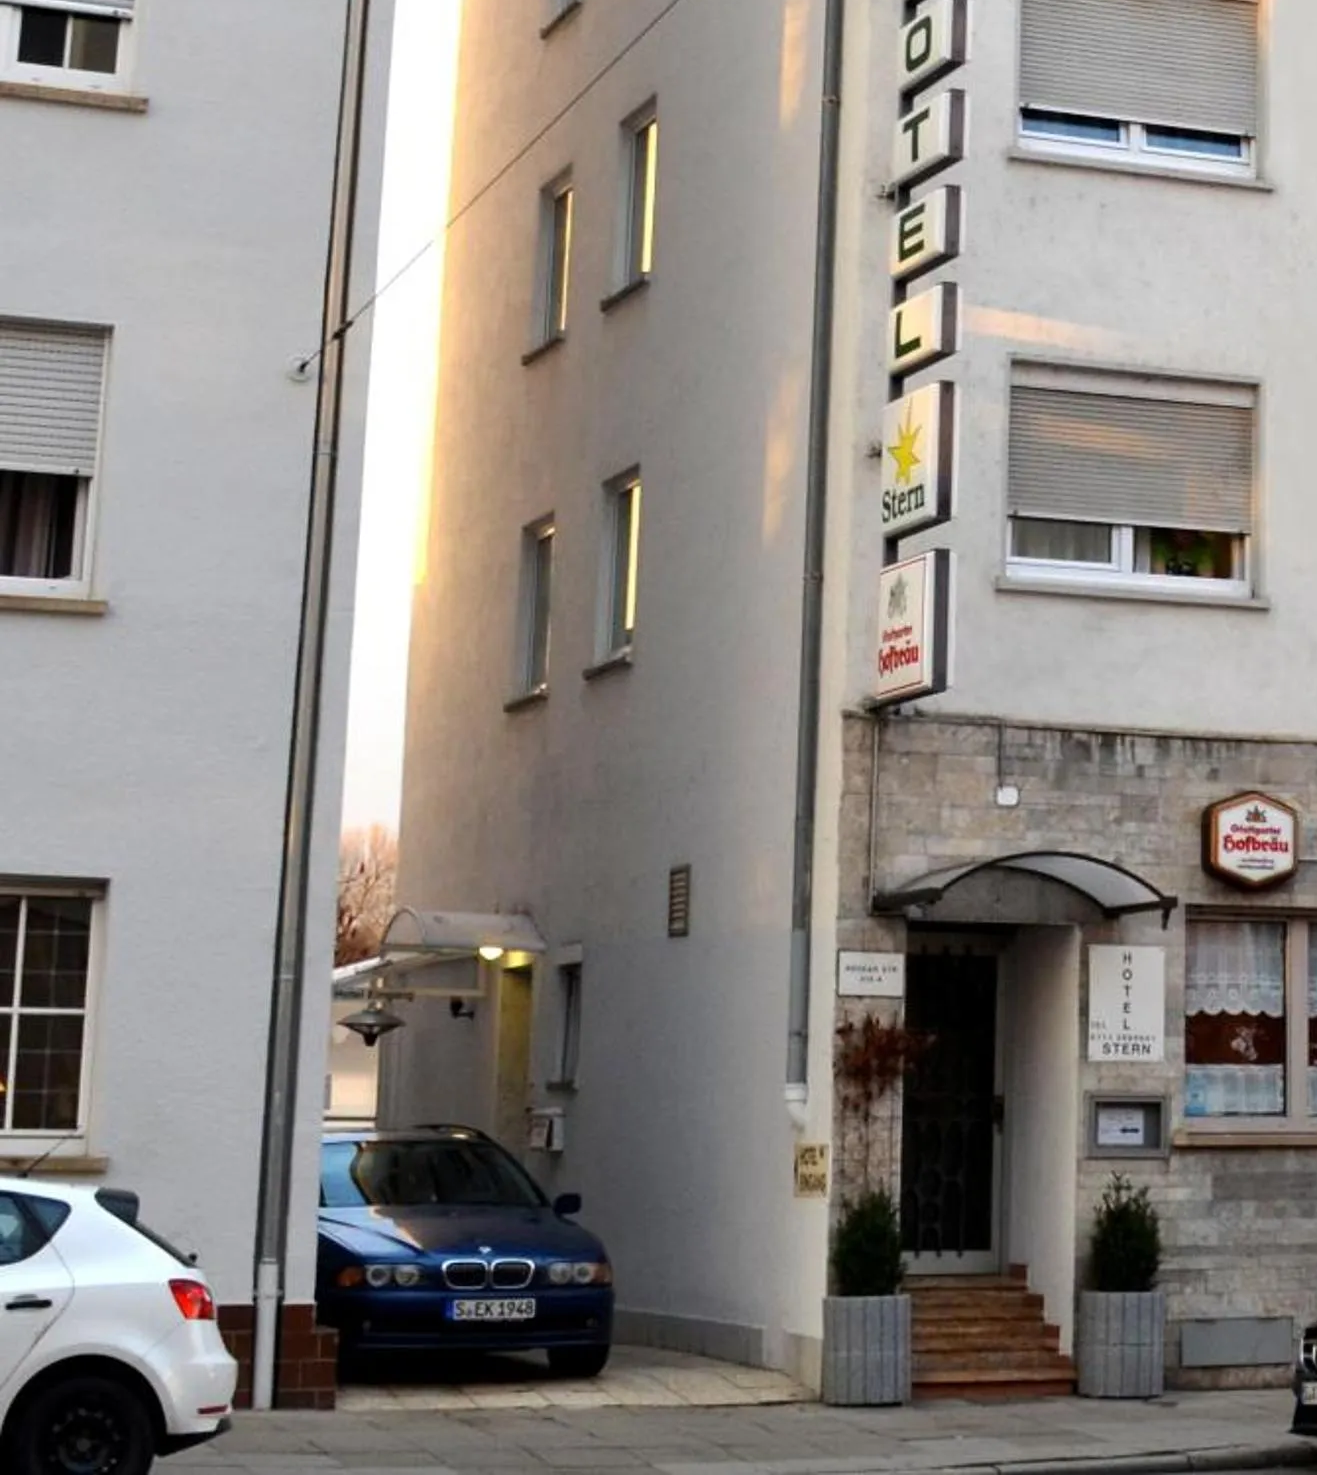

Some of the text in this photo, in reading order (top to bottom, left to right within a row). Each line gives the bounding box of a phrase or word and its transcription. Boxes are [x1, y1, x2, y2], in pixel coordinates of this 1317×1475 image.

[881, 483, 926, 524] Stern
[1121, 951, 1134, 1031] HOTEL
[1102, 1041, 1152, 1056] STERN
